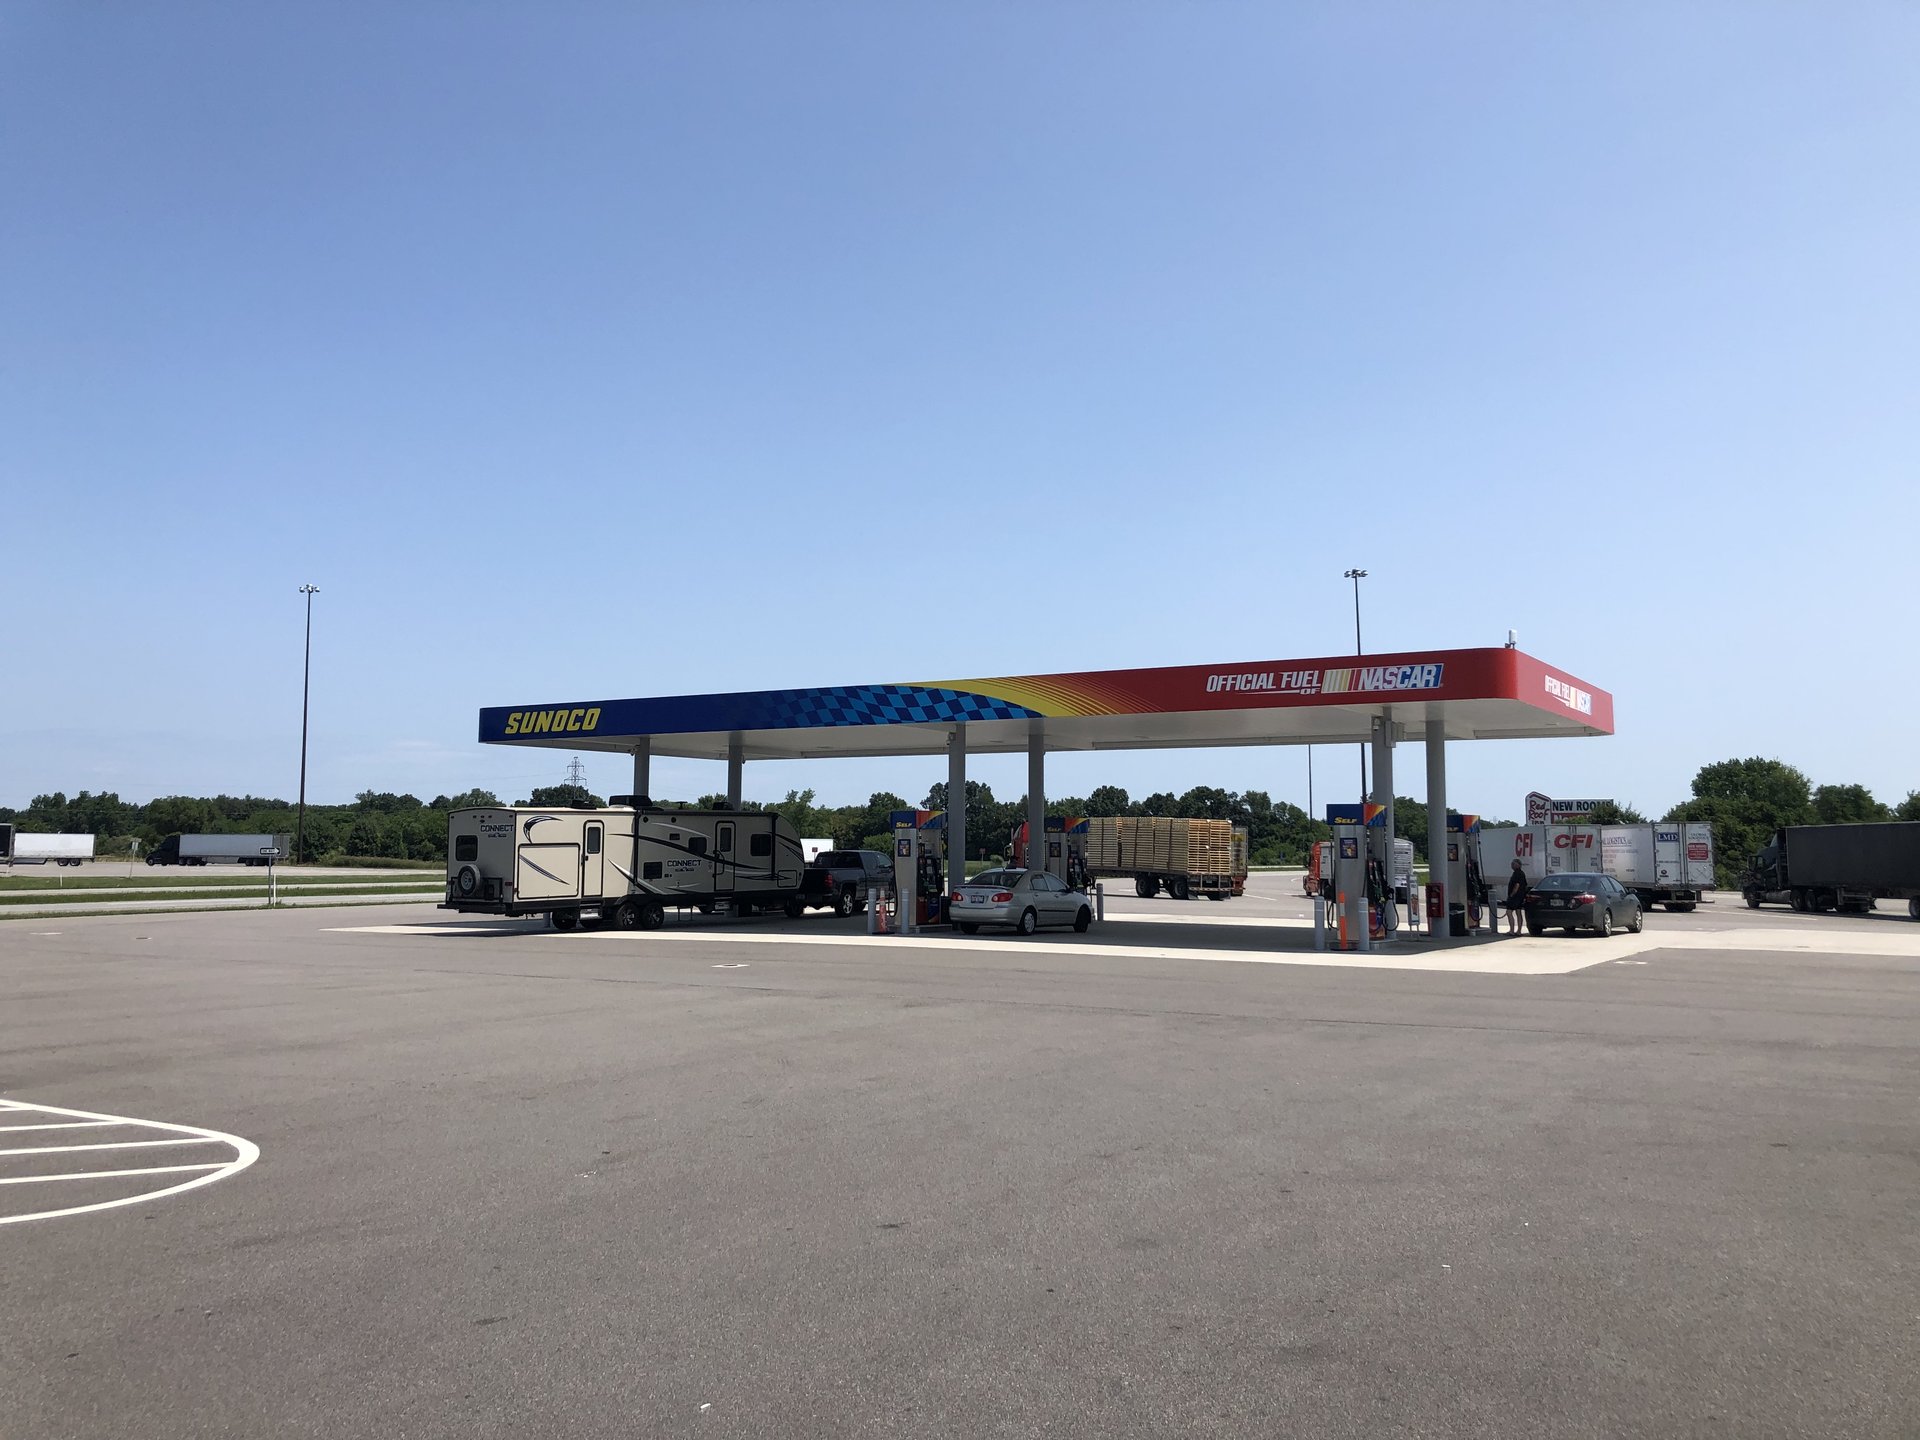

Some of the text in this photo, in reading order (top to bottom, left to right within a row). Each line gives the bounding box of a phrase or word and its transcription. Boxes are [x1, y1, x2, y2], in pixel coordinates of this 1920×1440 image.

[1206, 664, 1437, 692] OFFICIAL FUEL NASCAR
[505, 708, 601, 734] SUNOCO
[1529, 800, 1546, 810] Red
[1553, 802, 1573, 811] NEW
[1529, 809, 1550, 820] Roof
[1554, 834, 1594, 848] CFI
[1658, 833, 1679, 841] LMD
[1515, 833, 1533, 857] CFI
